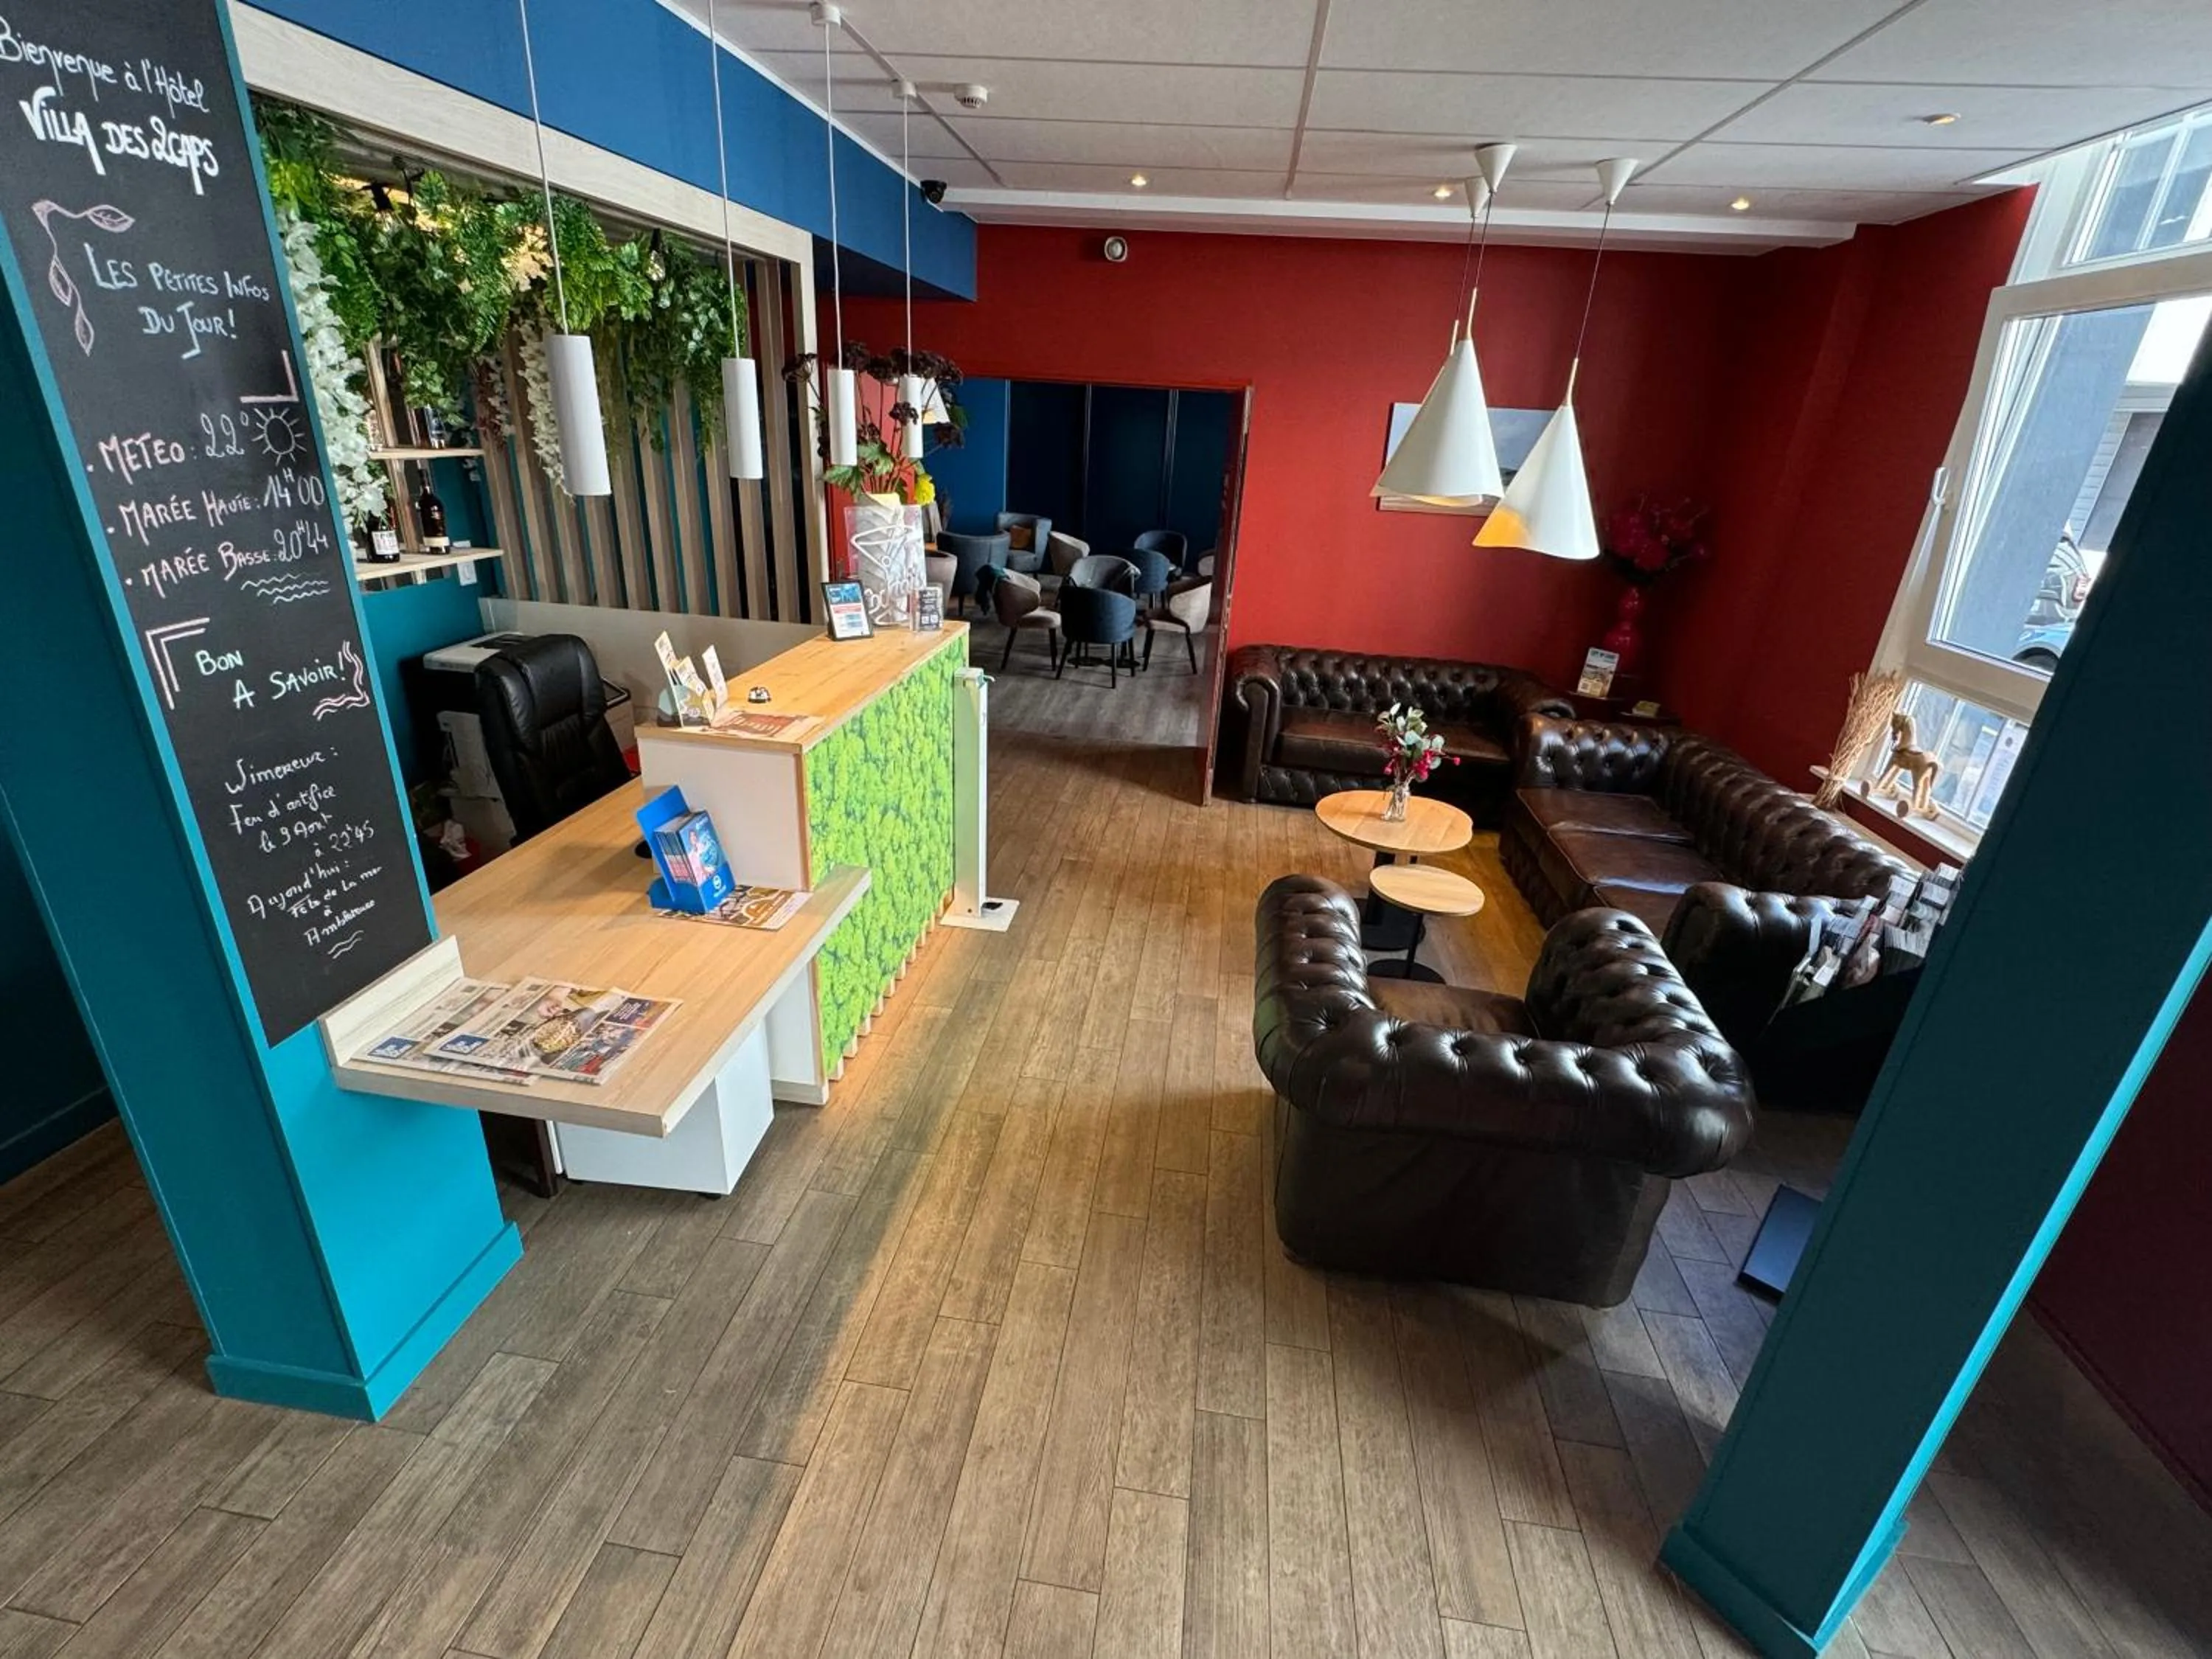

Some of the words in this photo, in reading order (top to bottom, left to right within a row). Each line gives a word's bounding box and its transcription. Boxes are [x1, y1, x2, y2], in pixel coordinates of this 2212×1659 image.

[0, 15, 117, 102] Bienvenue
[124, 61, 142, 91] à
[141, 58, 210, 119] l'Hôtel
[101, 122, 150, 159] DES
[83, 243, 139, 290] LES
[147, 262, 219, 295] PETITES
[138, 306, 175, 334] DU
[118, 494, 198, 546] MARÉE
[141, 546, 211, 599] MARÉE
[195, 650, 244, 675] BON
[233, 679, 256, 709] A
